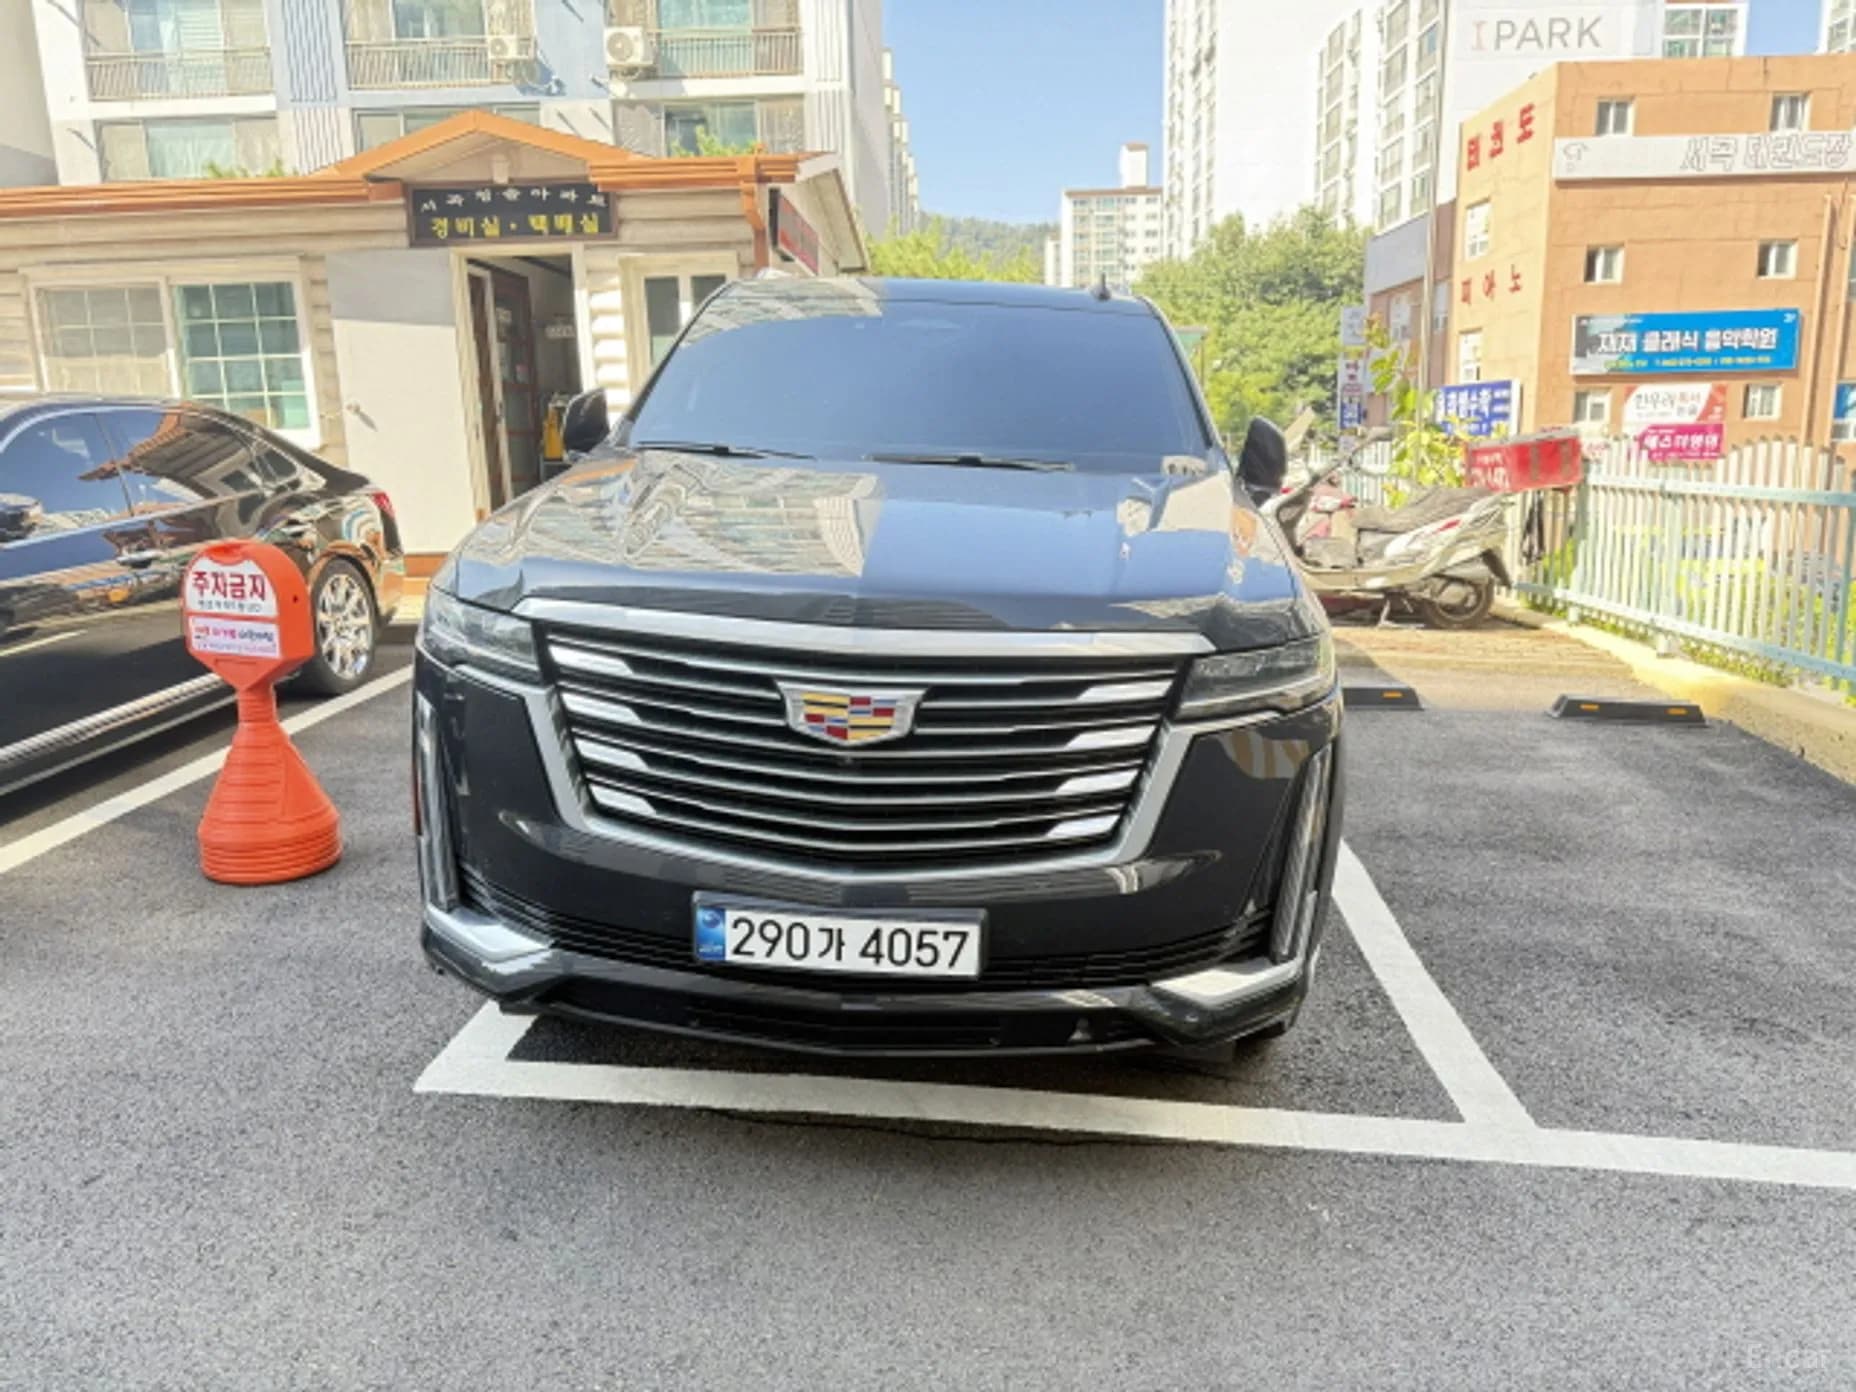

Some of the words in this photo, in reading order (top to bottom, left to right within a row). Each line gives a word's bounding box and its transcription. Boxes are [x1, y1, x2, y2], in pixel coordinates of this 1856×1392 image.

[1680, 136, 1739, 172] 서곡
[431, 214, 500, 240] 경비실
[1642, 329, 1699, 353] 클래식
[192, 571, 266, 602] 주차금지
[731, 916, 846, 963] 290가
[858, 926, 970, 969] 4057
